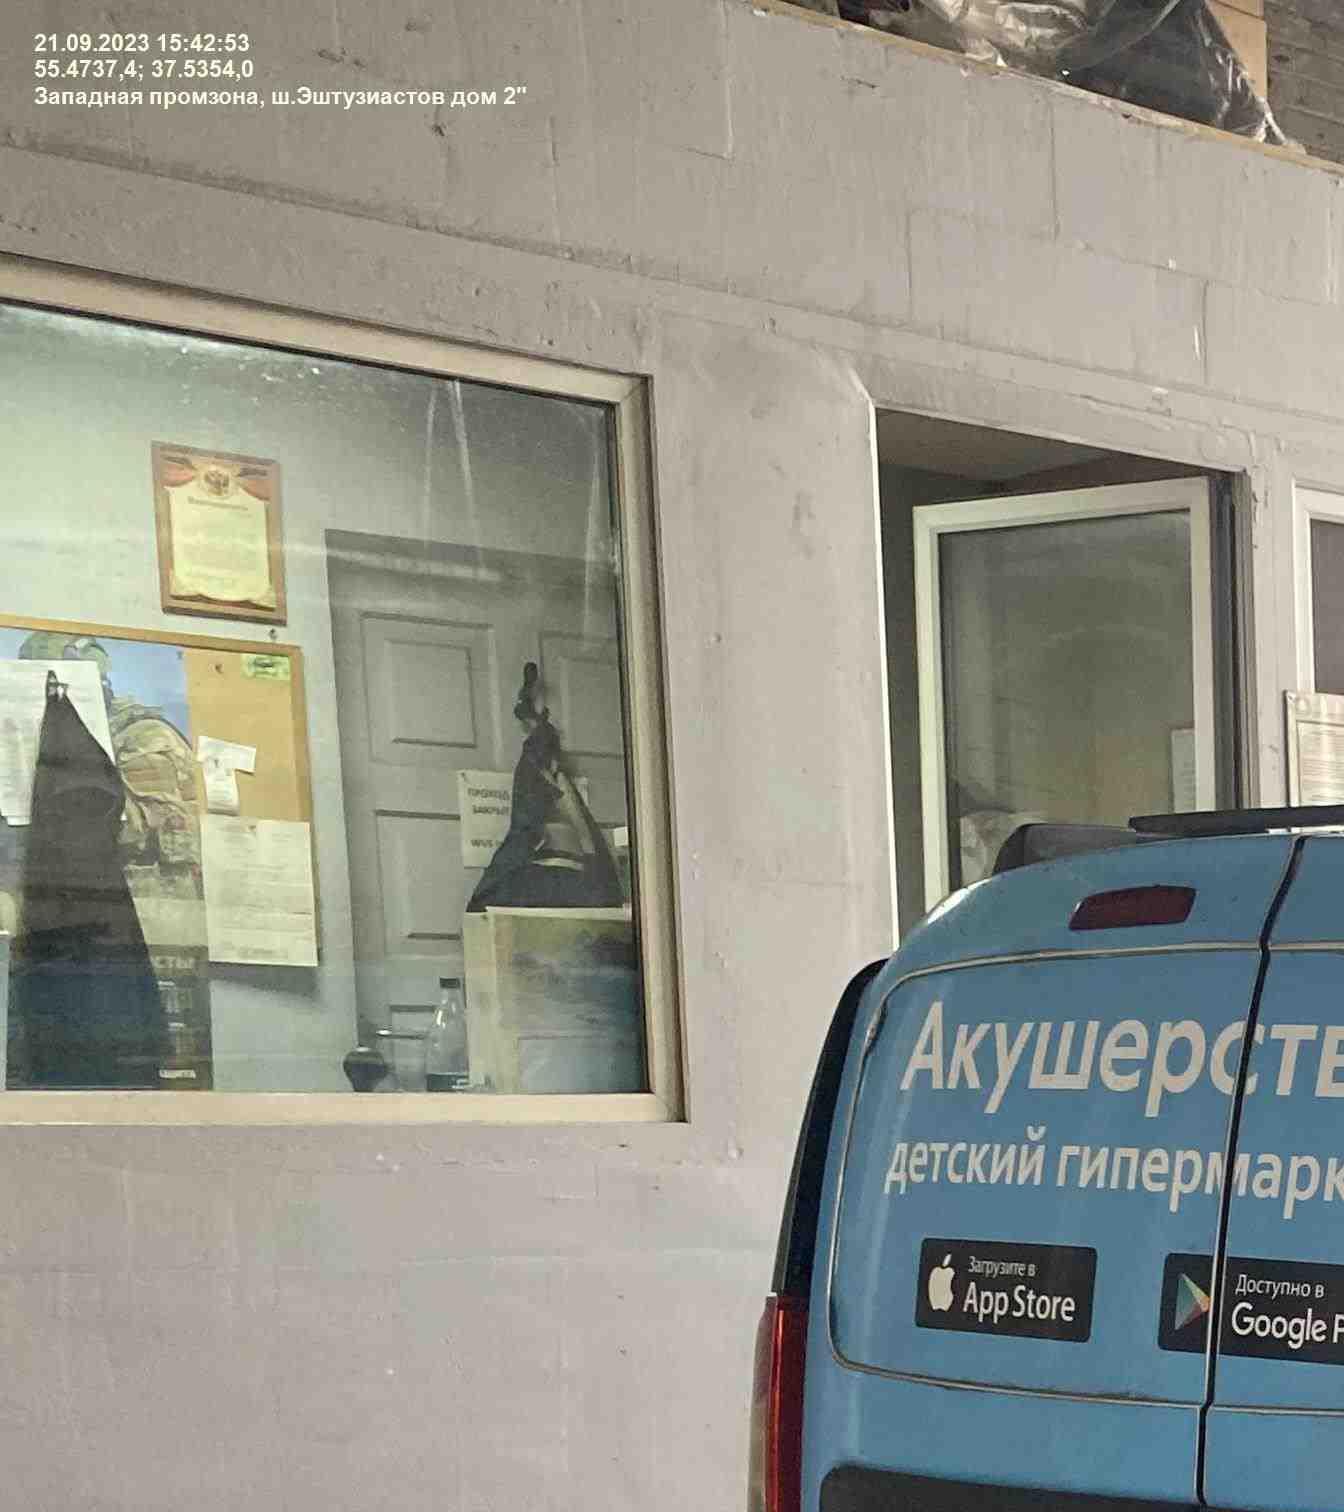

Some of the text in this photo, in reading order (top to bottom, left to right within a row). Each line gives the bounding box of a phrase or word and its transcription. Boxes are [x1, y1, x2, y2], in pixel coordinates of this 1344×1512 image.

[884, 1125, 1047, 1194] детский
[967, 1255, 1036, 1279] Загрузите в
[1235, 1274, 1325, 1300] Доступно в
[962, 1281, 1076, 1324] App Store
[1231, 1301, 1327, 1350] Google
